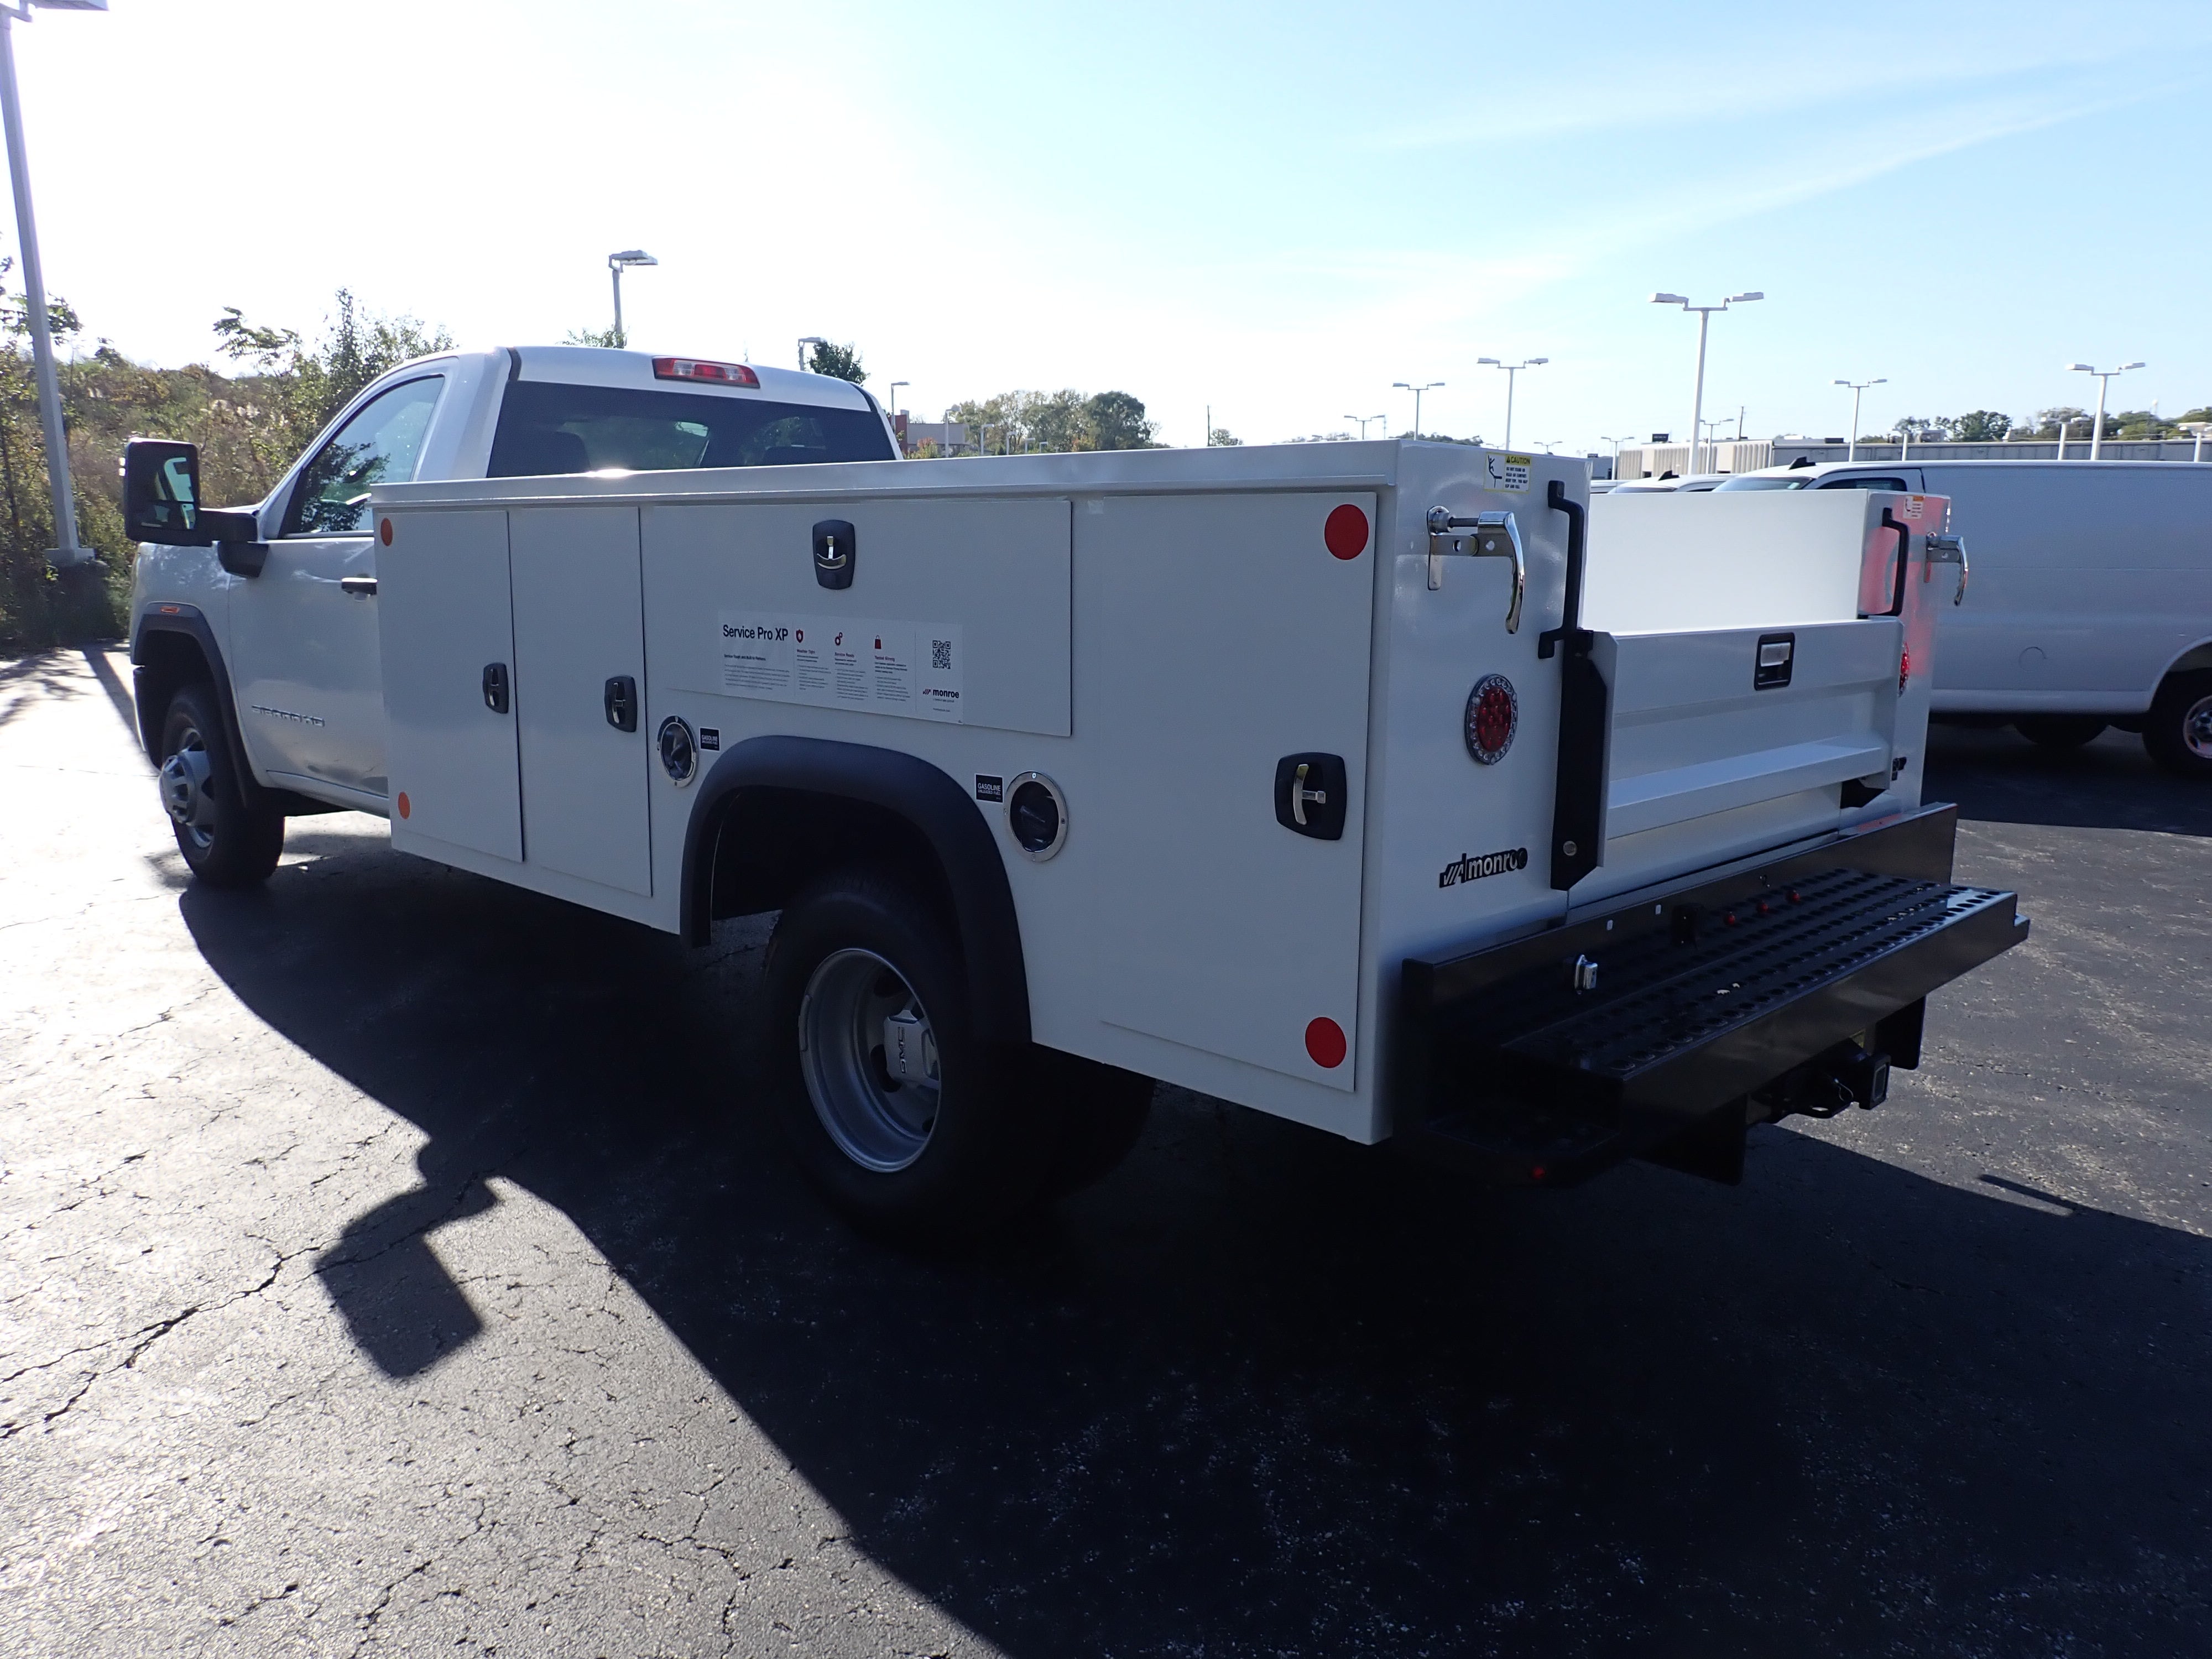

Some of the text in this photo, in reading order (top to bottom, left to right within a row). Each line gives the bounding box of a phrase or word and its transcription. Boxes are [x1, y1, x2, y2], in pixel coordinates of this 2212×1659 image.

[1511, 456, 1530, 465] CAUTION
[723, 624, 789, 641] Service Pro XP
[932, 689, 959, 698] monroe
[978, 783, 1001, 791] GASOLINE
[1468, 848, 1527, 880] monro
[898, 1026, 907, 1074] GMC
